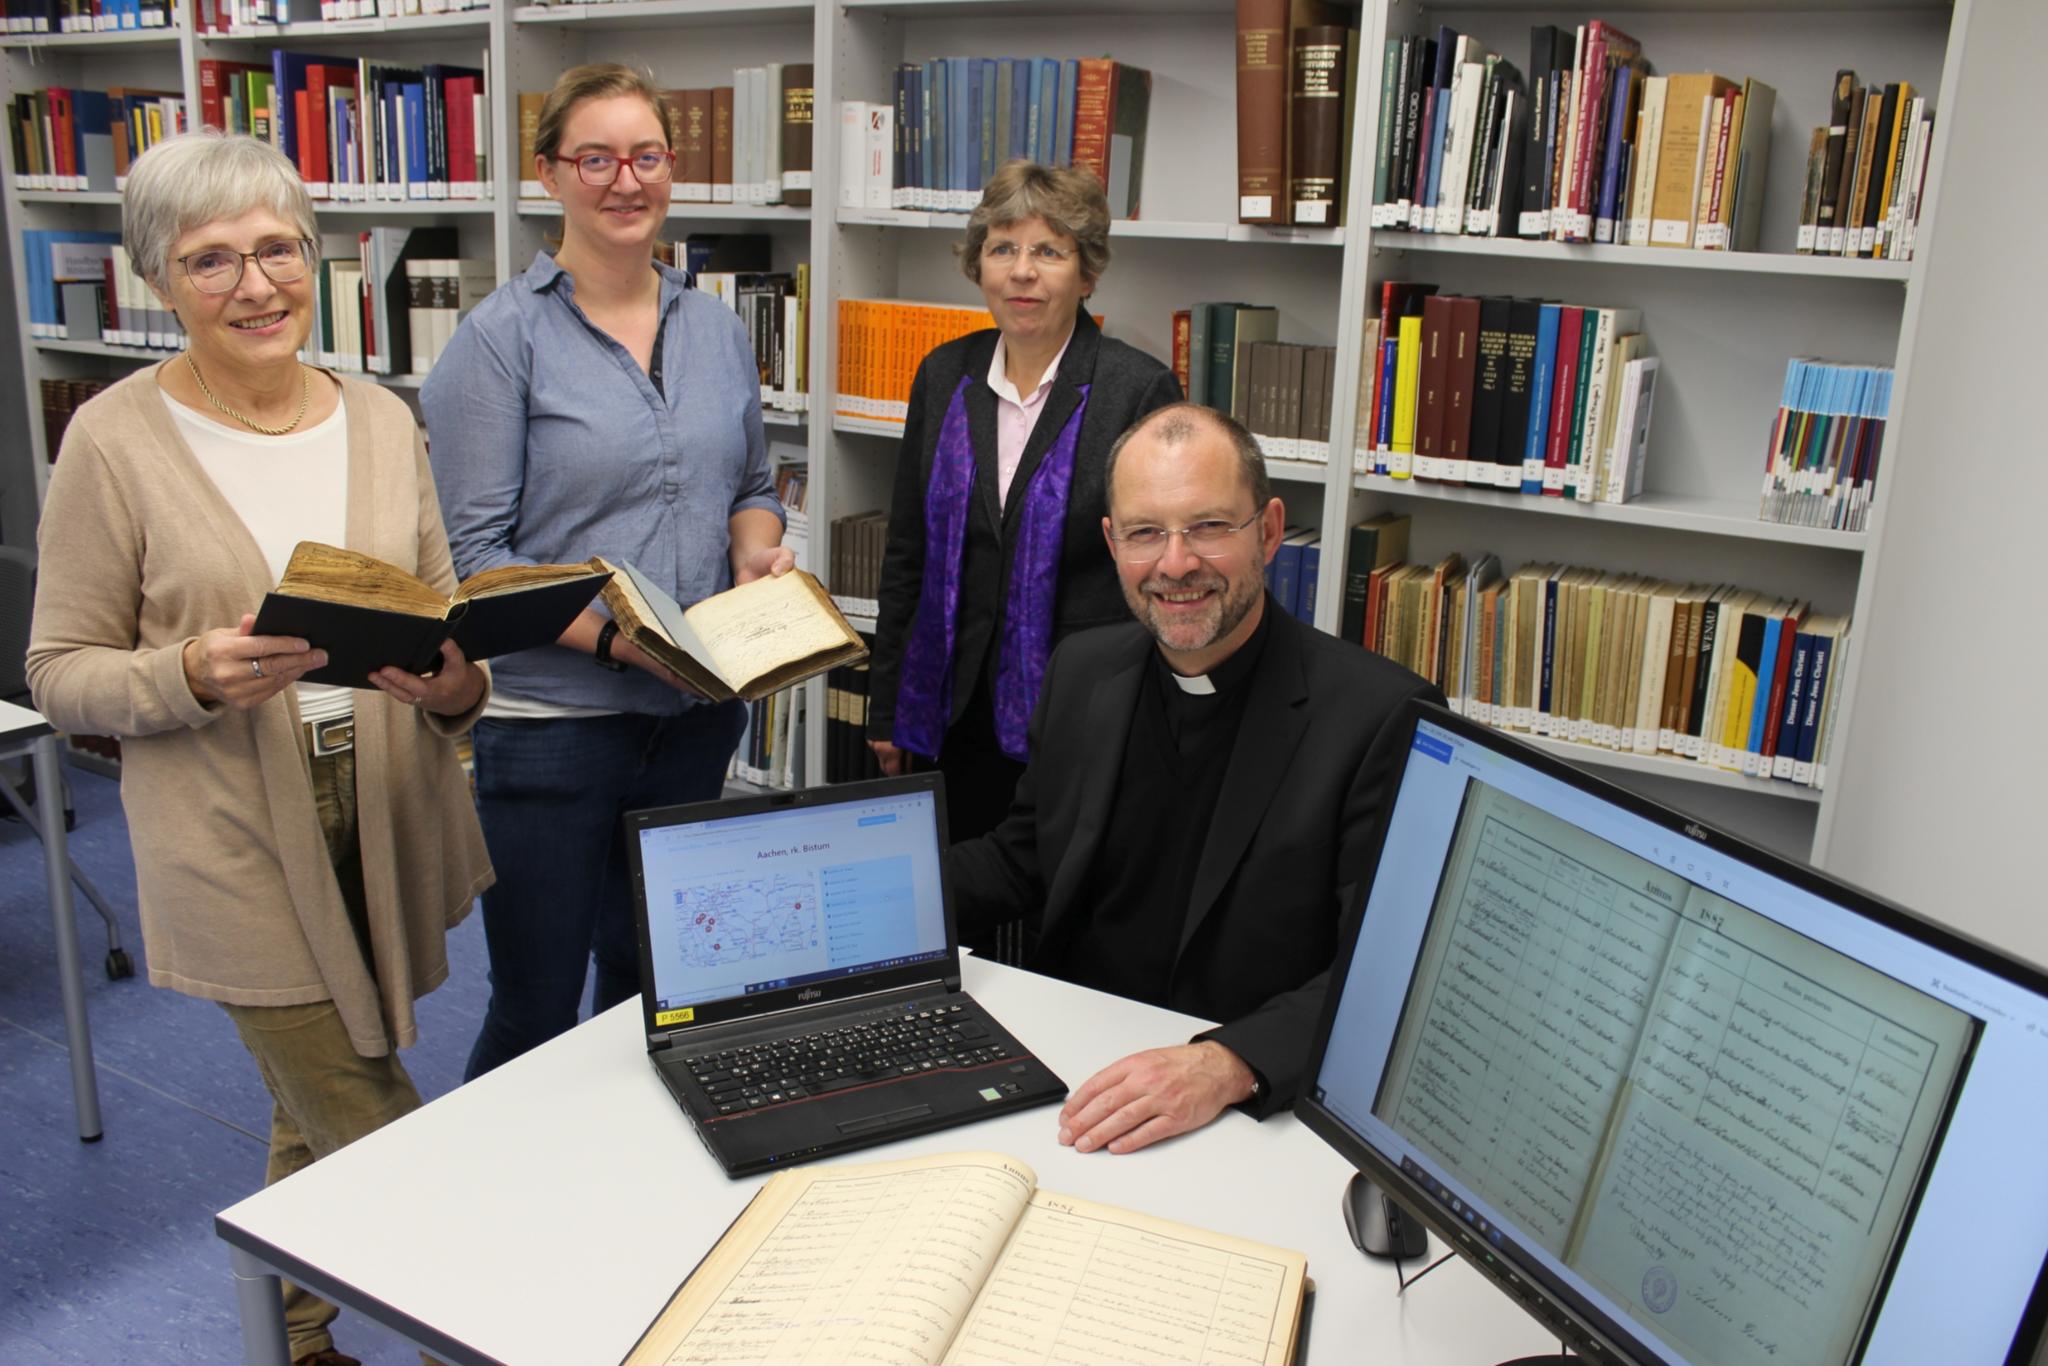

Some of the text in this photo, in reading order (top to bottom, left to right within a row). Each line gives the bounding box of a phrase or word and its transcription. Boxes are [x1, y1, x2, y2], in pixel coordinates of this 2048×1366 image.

[1672, 613, 1690, 657] WENAU
[1685, 615, 1703, 658] WENAU
[1700, 610, 1718, 653] WENAU
[1787, 649, 1806, 725] Diener Jesu Christi
[1805, 651, 1824, 726] Diener Jesu Christi
[757, 842, 830, 859] Aachen, rk. Bistum
[1684, 823, 1708, 841] FUJITSU
[798, 988, 821, 1001] FUJITSU
